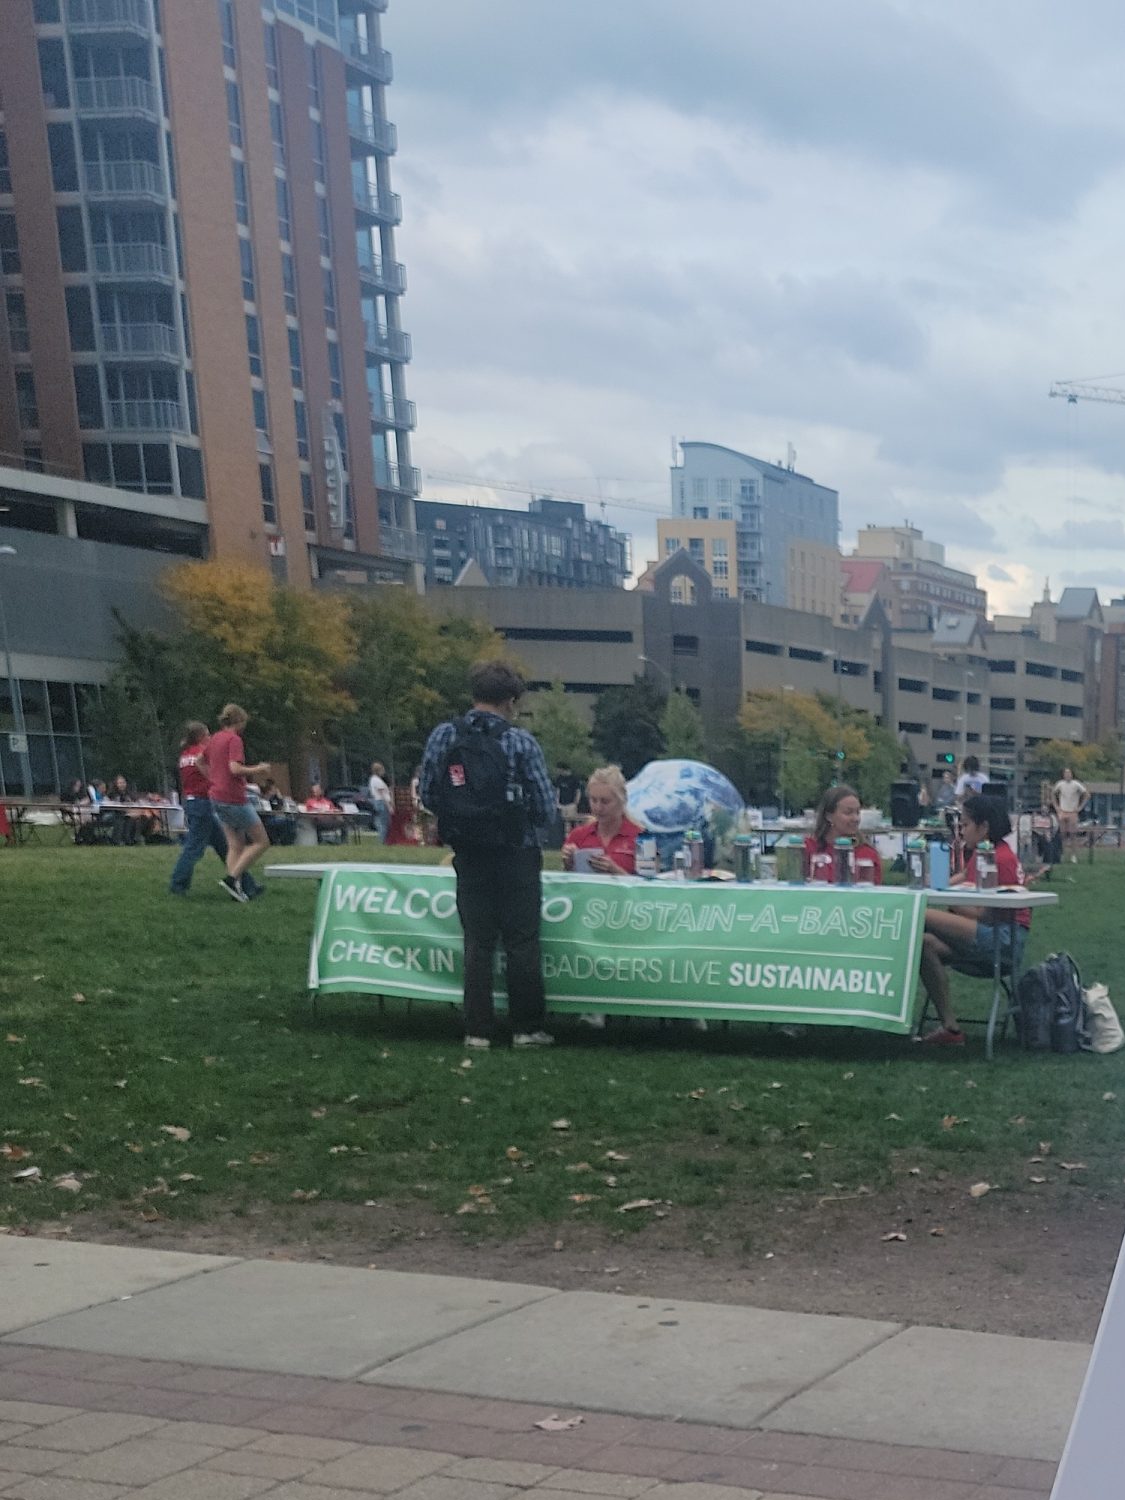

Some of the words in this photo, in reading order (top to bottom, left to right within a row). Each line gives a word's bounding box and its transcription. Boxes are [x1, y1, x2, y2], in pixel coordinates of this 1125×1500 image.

[335, 884, 457, 920] WELCO
[541, 896, 573, 923] O
[582, 898, 904, 941] SUSTAIN-A-BASH
[326, 939, 424, 973] CHECK
[429, 948, 455, 973] IN
[542, 953, 663, 983] BADGERS
[669, 959, 722, 985] LIVE
[728, 961, 895, 998] SUSTAINABLY.
